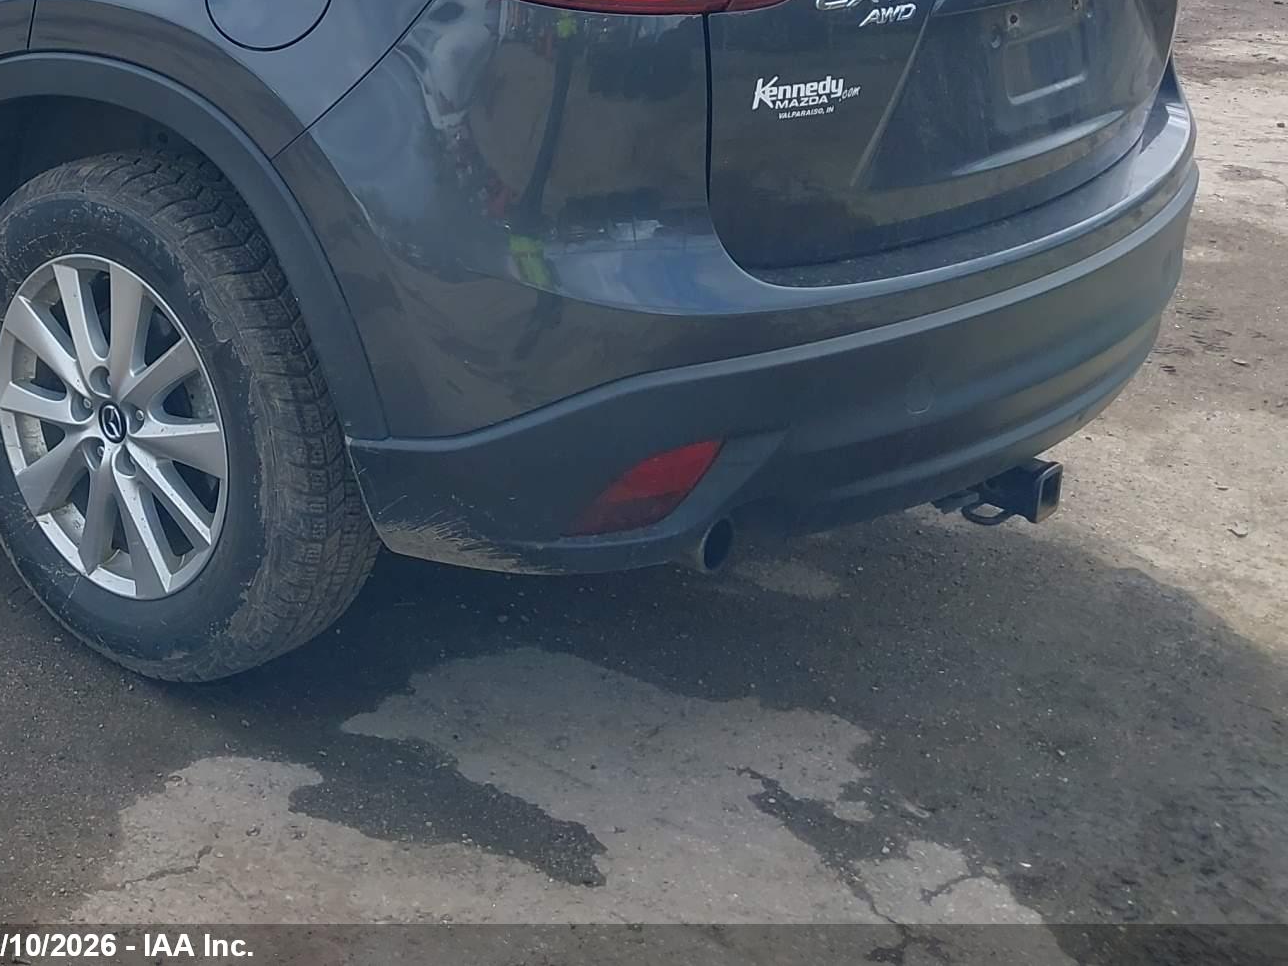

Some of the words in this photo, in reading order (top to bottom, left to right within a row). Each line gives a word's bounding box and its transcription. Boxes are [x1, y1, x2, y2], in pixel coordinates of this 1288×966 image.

[858, 3, 917, 27] AWD
[774, 94, 828, 109] MAZDA
[778, 107, 824, 119] VALPARAISO,
[825, 105, 835, 113] IN
